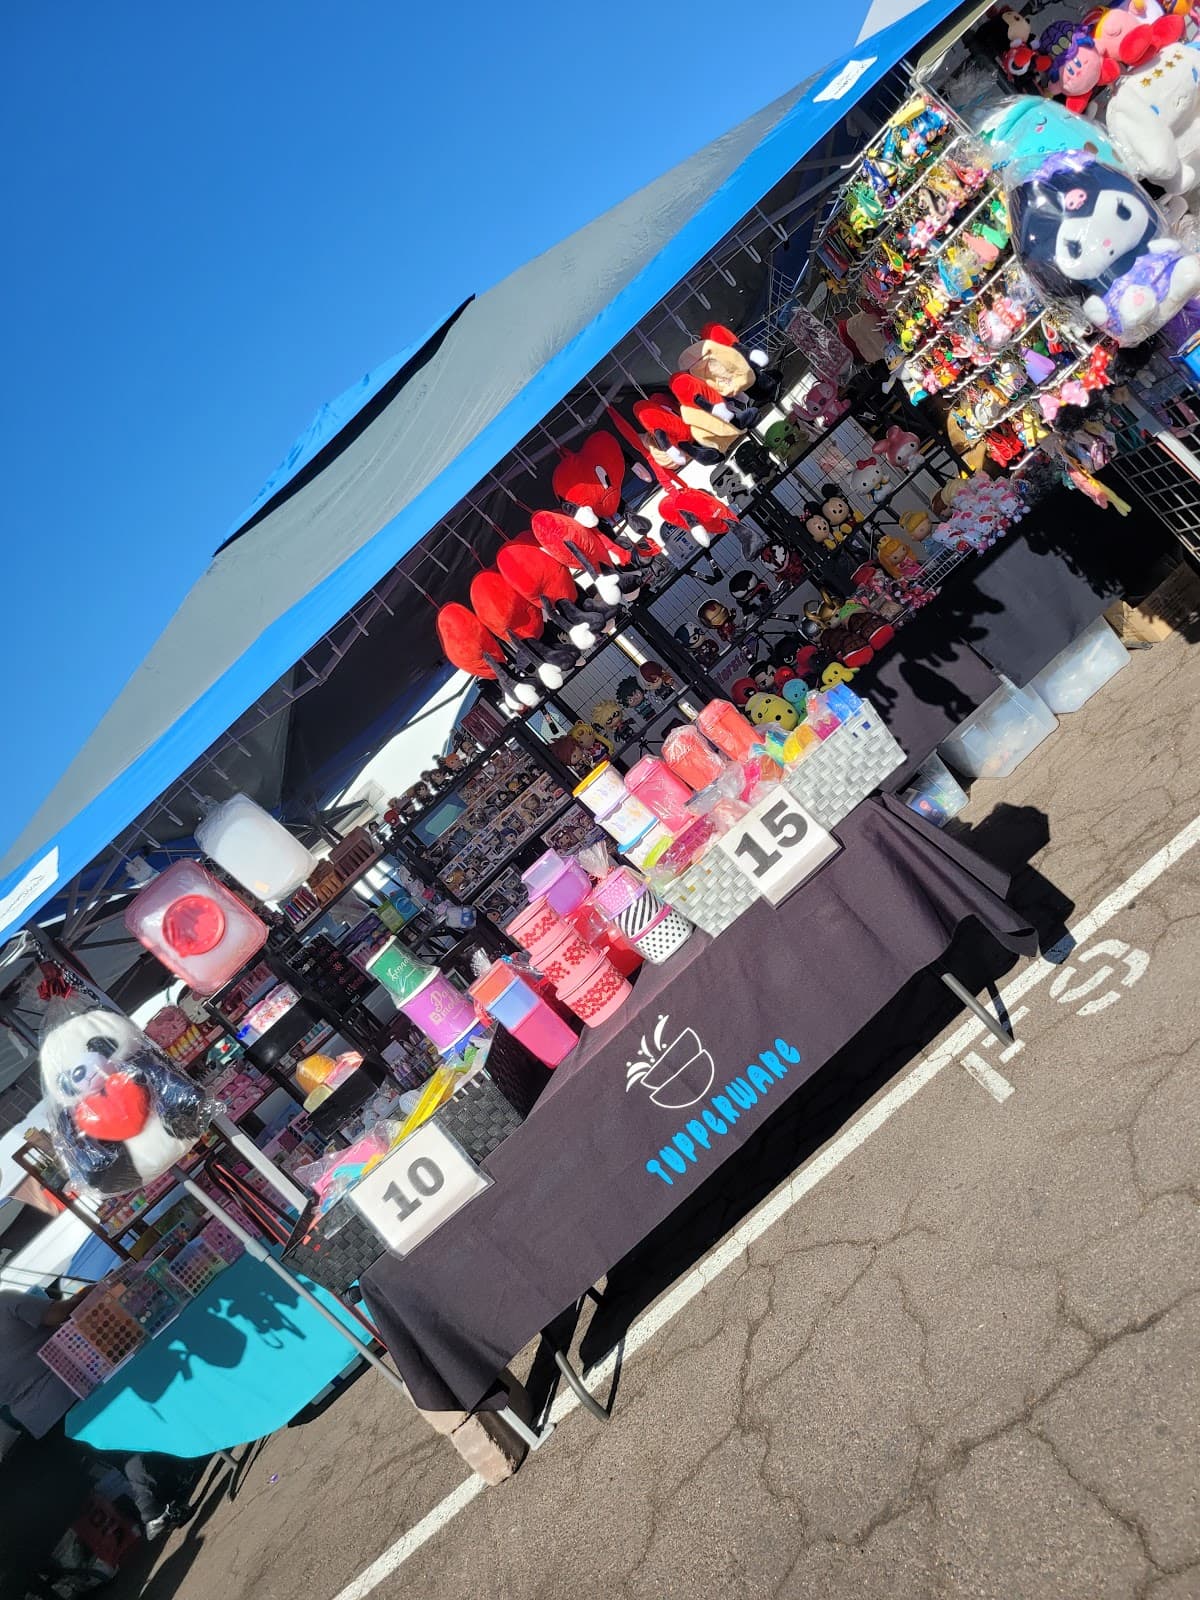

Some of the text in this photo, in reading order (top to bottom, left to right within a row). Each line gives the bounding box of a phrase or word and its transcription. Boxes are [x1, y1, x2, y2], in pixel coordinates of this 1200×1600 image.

[734, 799, 808, 878] 15
[645, 1038, 800, 1185] TUPPERWARE
[382, 1157, 444, 1222] 10
